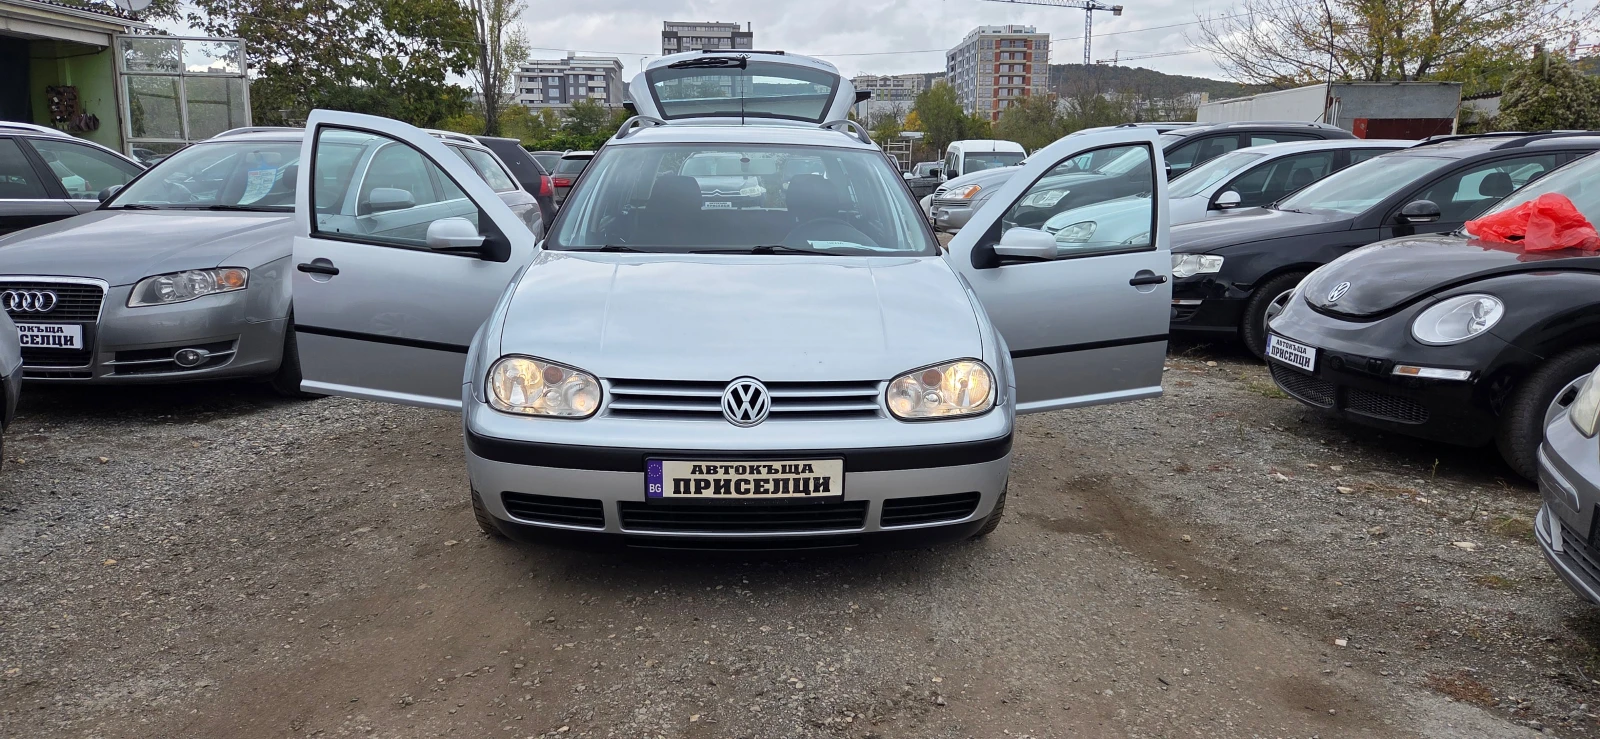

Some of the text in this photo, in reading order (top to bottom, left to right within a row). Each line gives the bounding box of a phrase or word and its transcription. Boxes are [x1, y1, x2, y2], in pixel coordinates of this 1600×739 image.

[16, 325, 64, 334] ОКЪЩА
[20, 334, 75, 347] СЕЛЦИ
[1276, 339, 1307, 355] АВТОКЪЩА
[1271, 345, 1311, 368] ПРИСЕЛЦИ
[723, 379, 769, 425] VW
[690, 464, 814, 475] АВТОКЪЩА
[649, 483, 661, 493] BG
[672, 476, 831, 495] ПРИСЕЛЦИ
